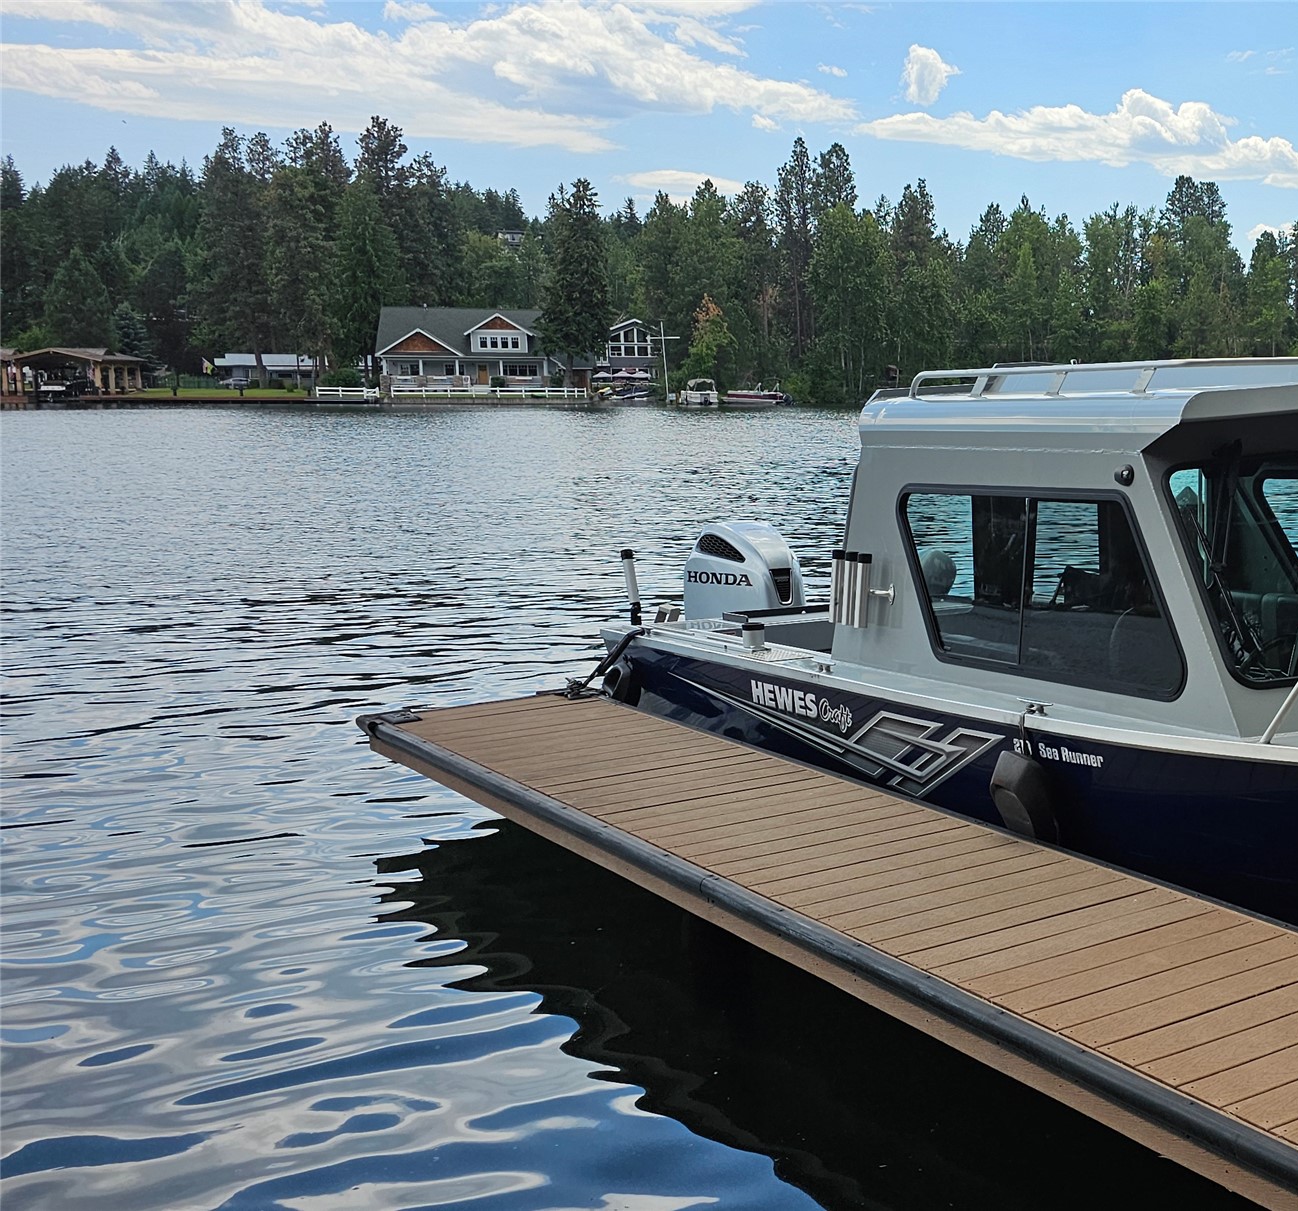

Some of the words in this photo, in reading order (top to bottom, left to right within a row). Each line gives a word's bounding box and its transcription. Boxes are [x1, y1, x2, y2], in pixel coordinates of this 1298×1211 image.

[687, 570, 753, 587] HONDA
[750, 679, 818, 718] HEWES
[818, 697, 853, 733] Craft
[1038, 742, 1060, 761] Sea
[1060, 746, 1104, 768] Runner
